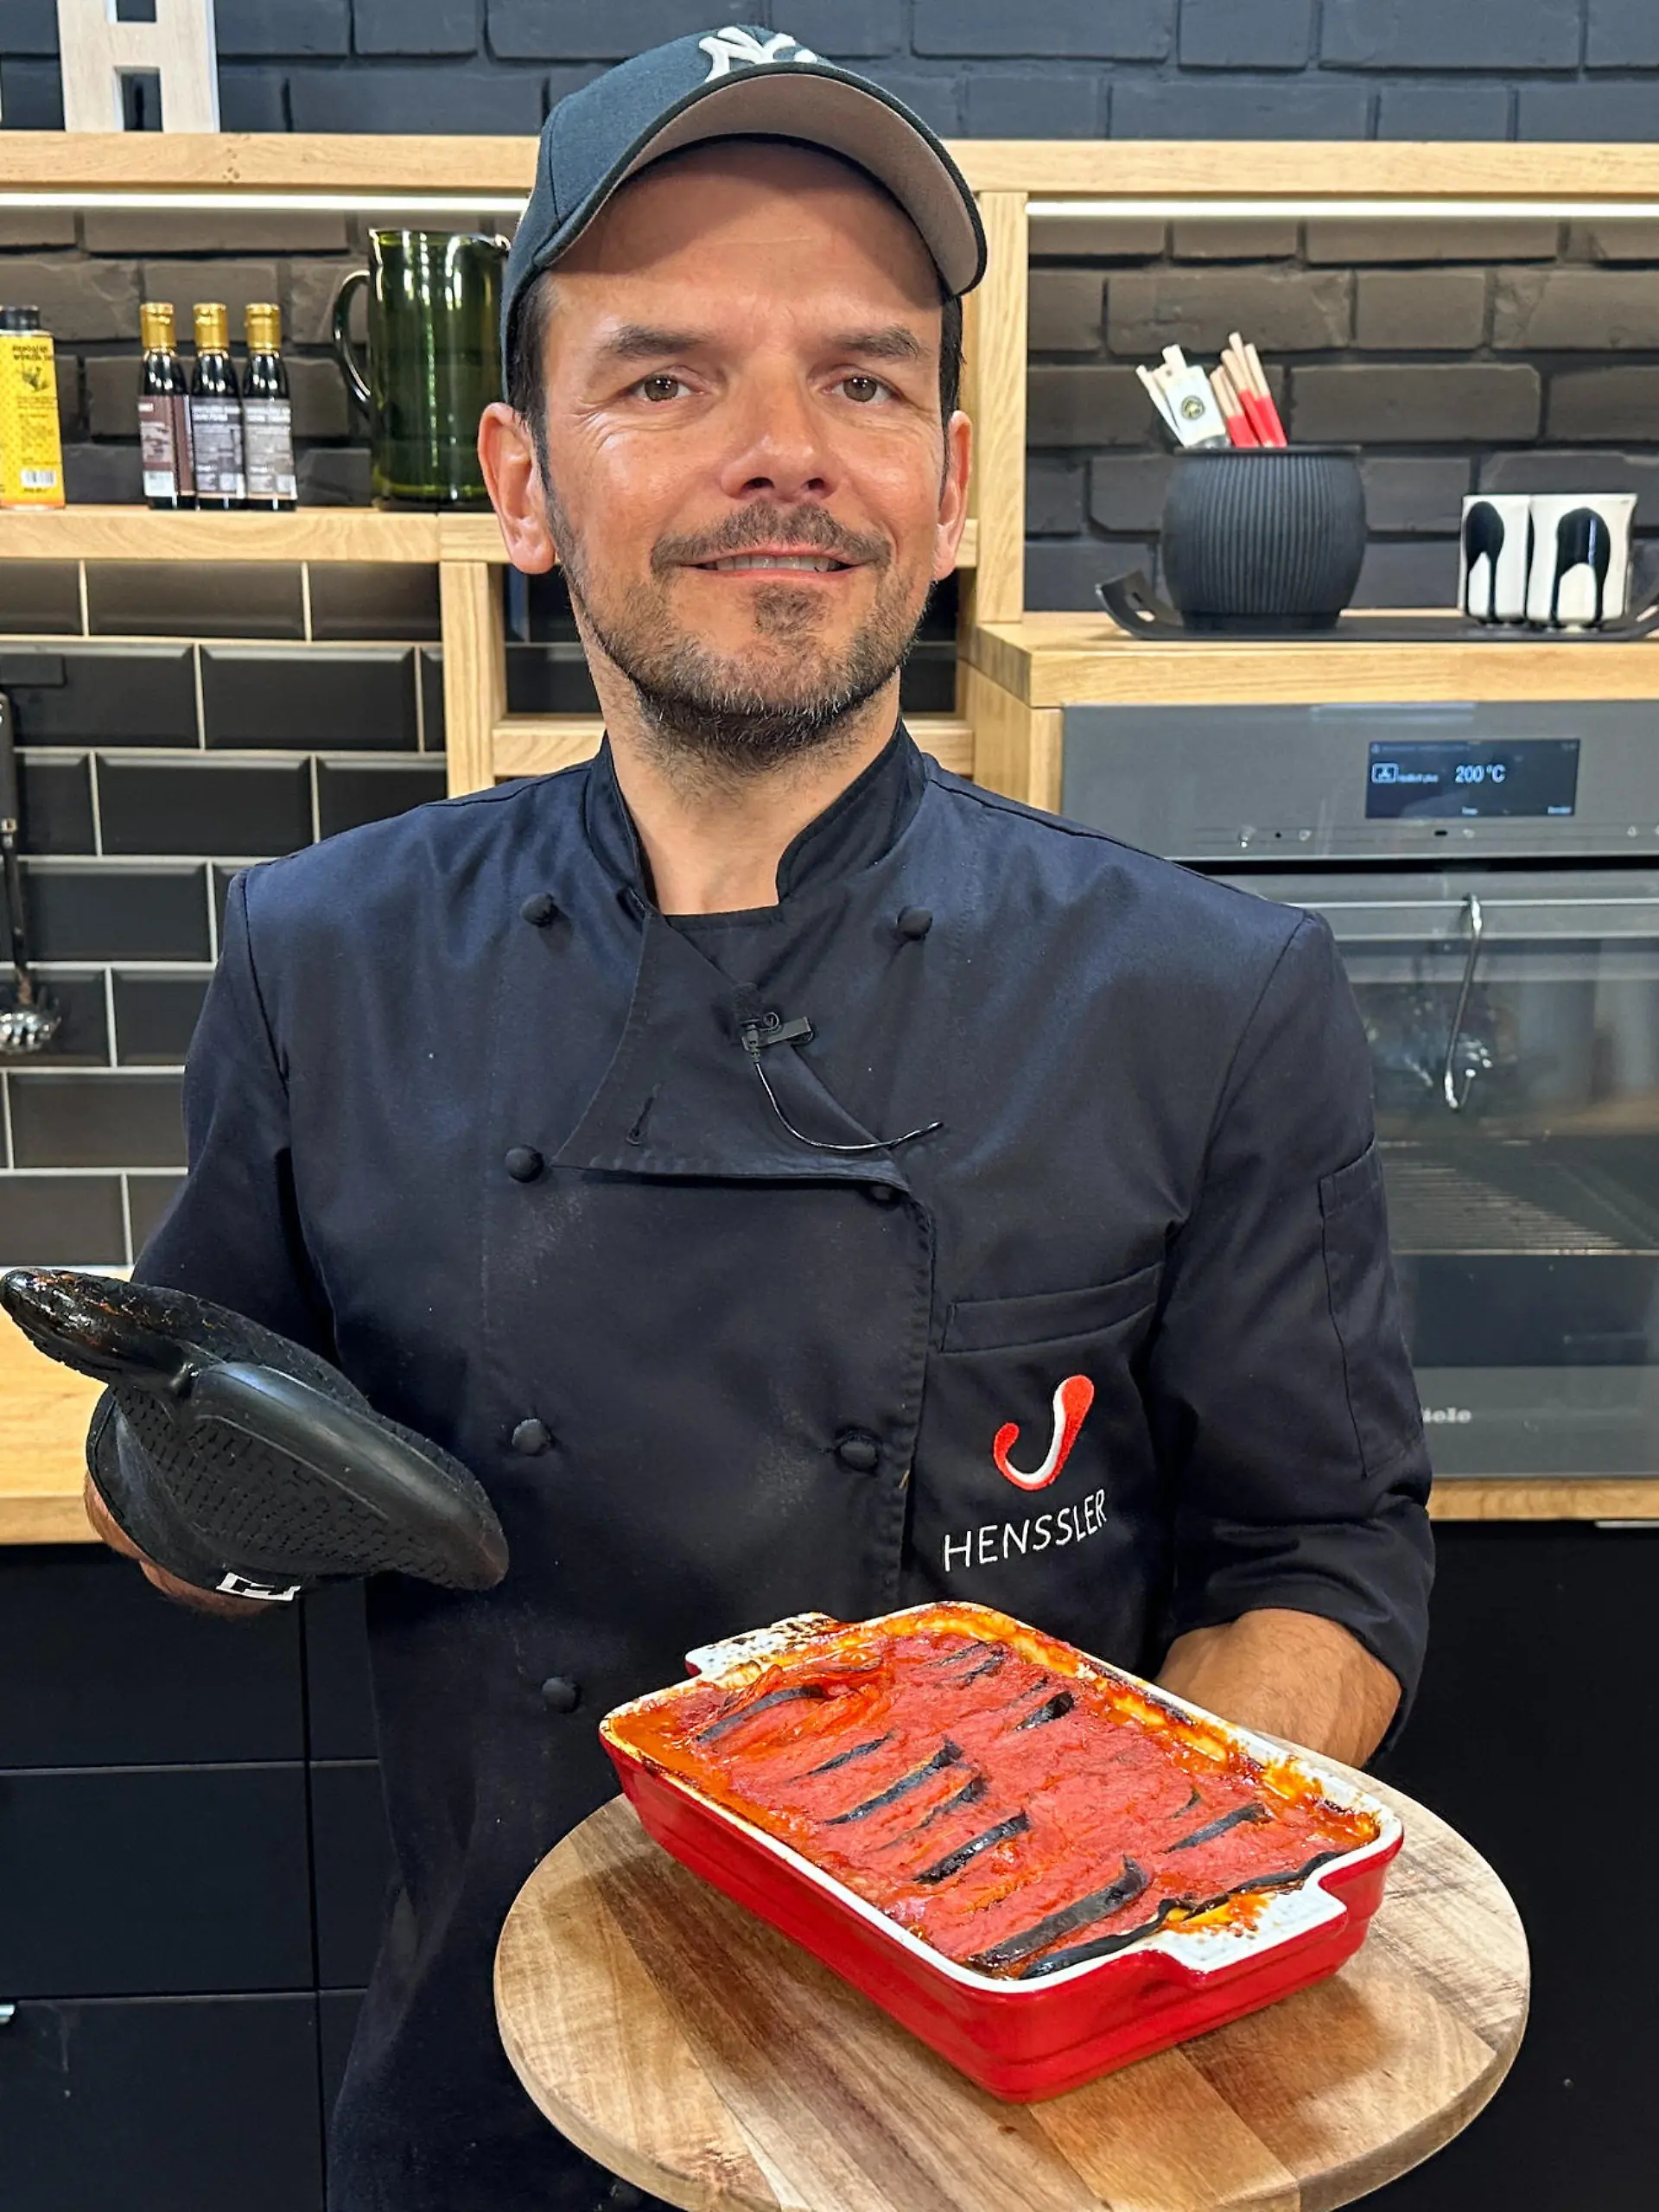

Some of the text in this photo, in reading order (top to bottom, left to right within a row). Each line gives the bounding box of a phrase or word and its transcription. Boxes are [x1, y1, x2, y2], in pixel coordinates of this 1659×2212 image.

[1455, 765, 1484, 783] 200
[1421, 1407, 1472, 1424] iele
[944, 1488, 1108, 1573] HENSSLER
